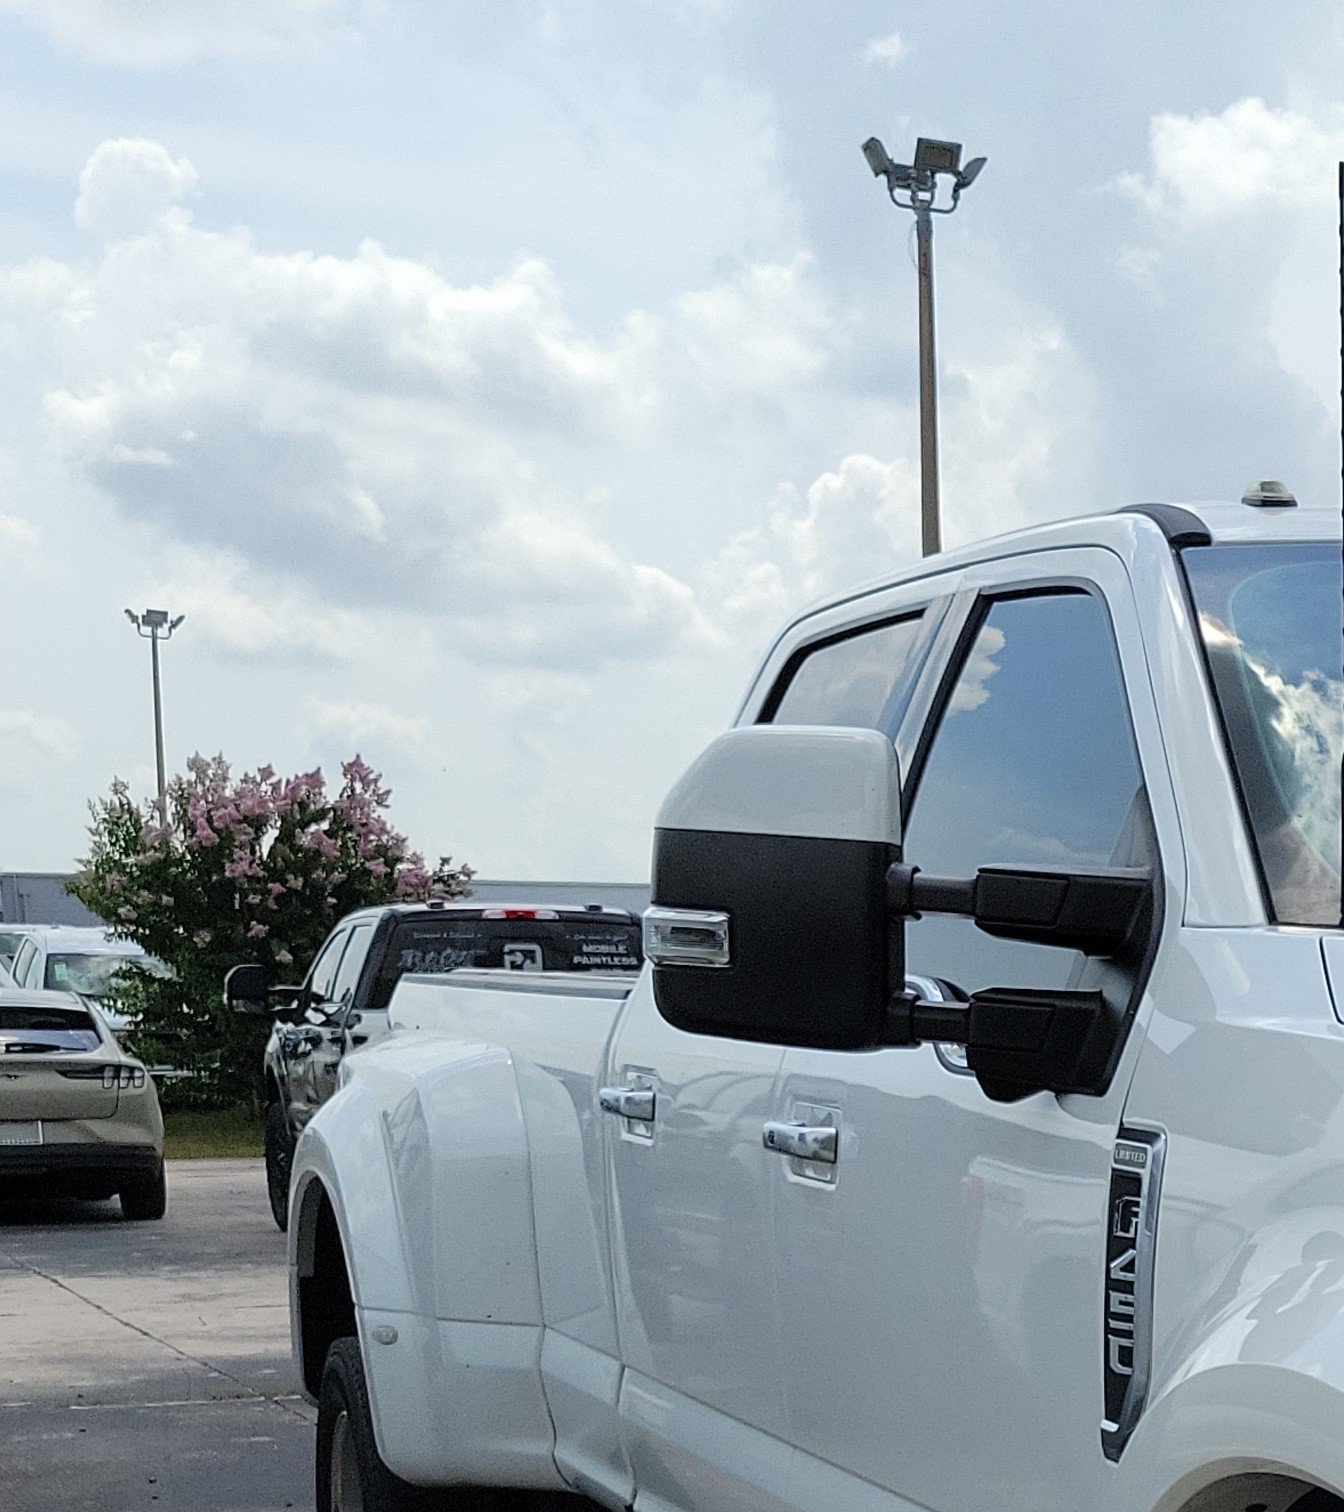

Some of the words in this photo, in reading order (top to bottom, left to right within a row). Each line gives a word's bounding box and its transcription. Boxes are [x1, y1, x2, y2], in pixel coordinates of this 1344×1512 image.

[582, 944, 628, 954] MOBILE
[573, 955, 638, 966] PAINTLESS
[1115, 1149, 1147, 1164] LIMITED
